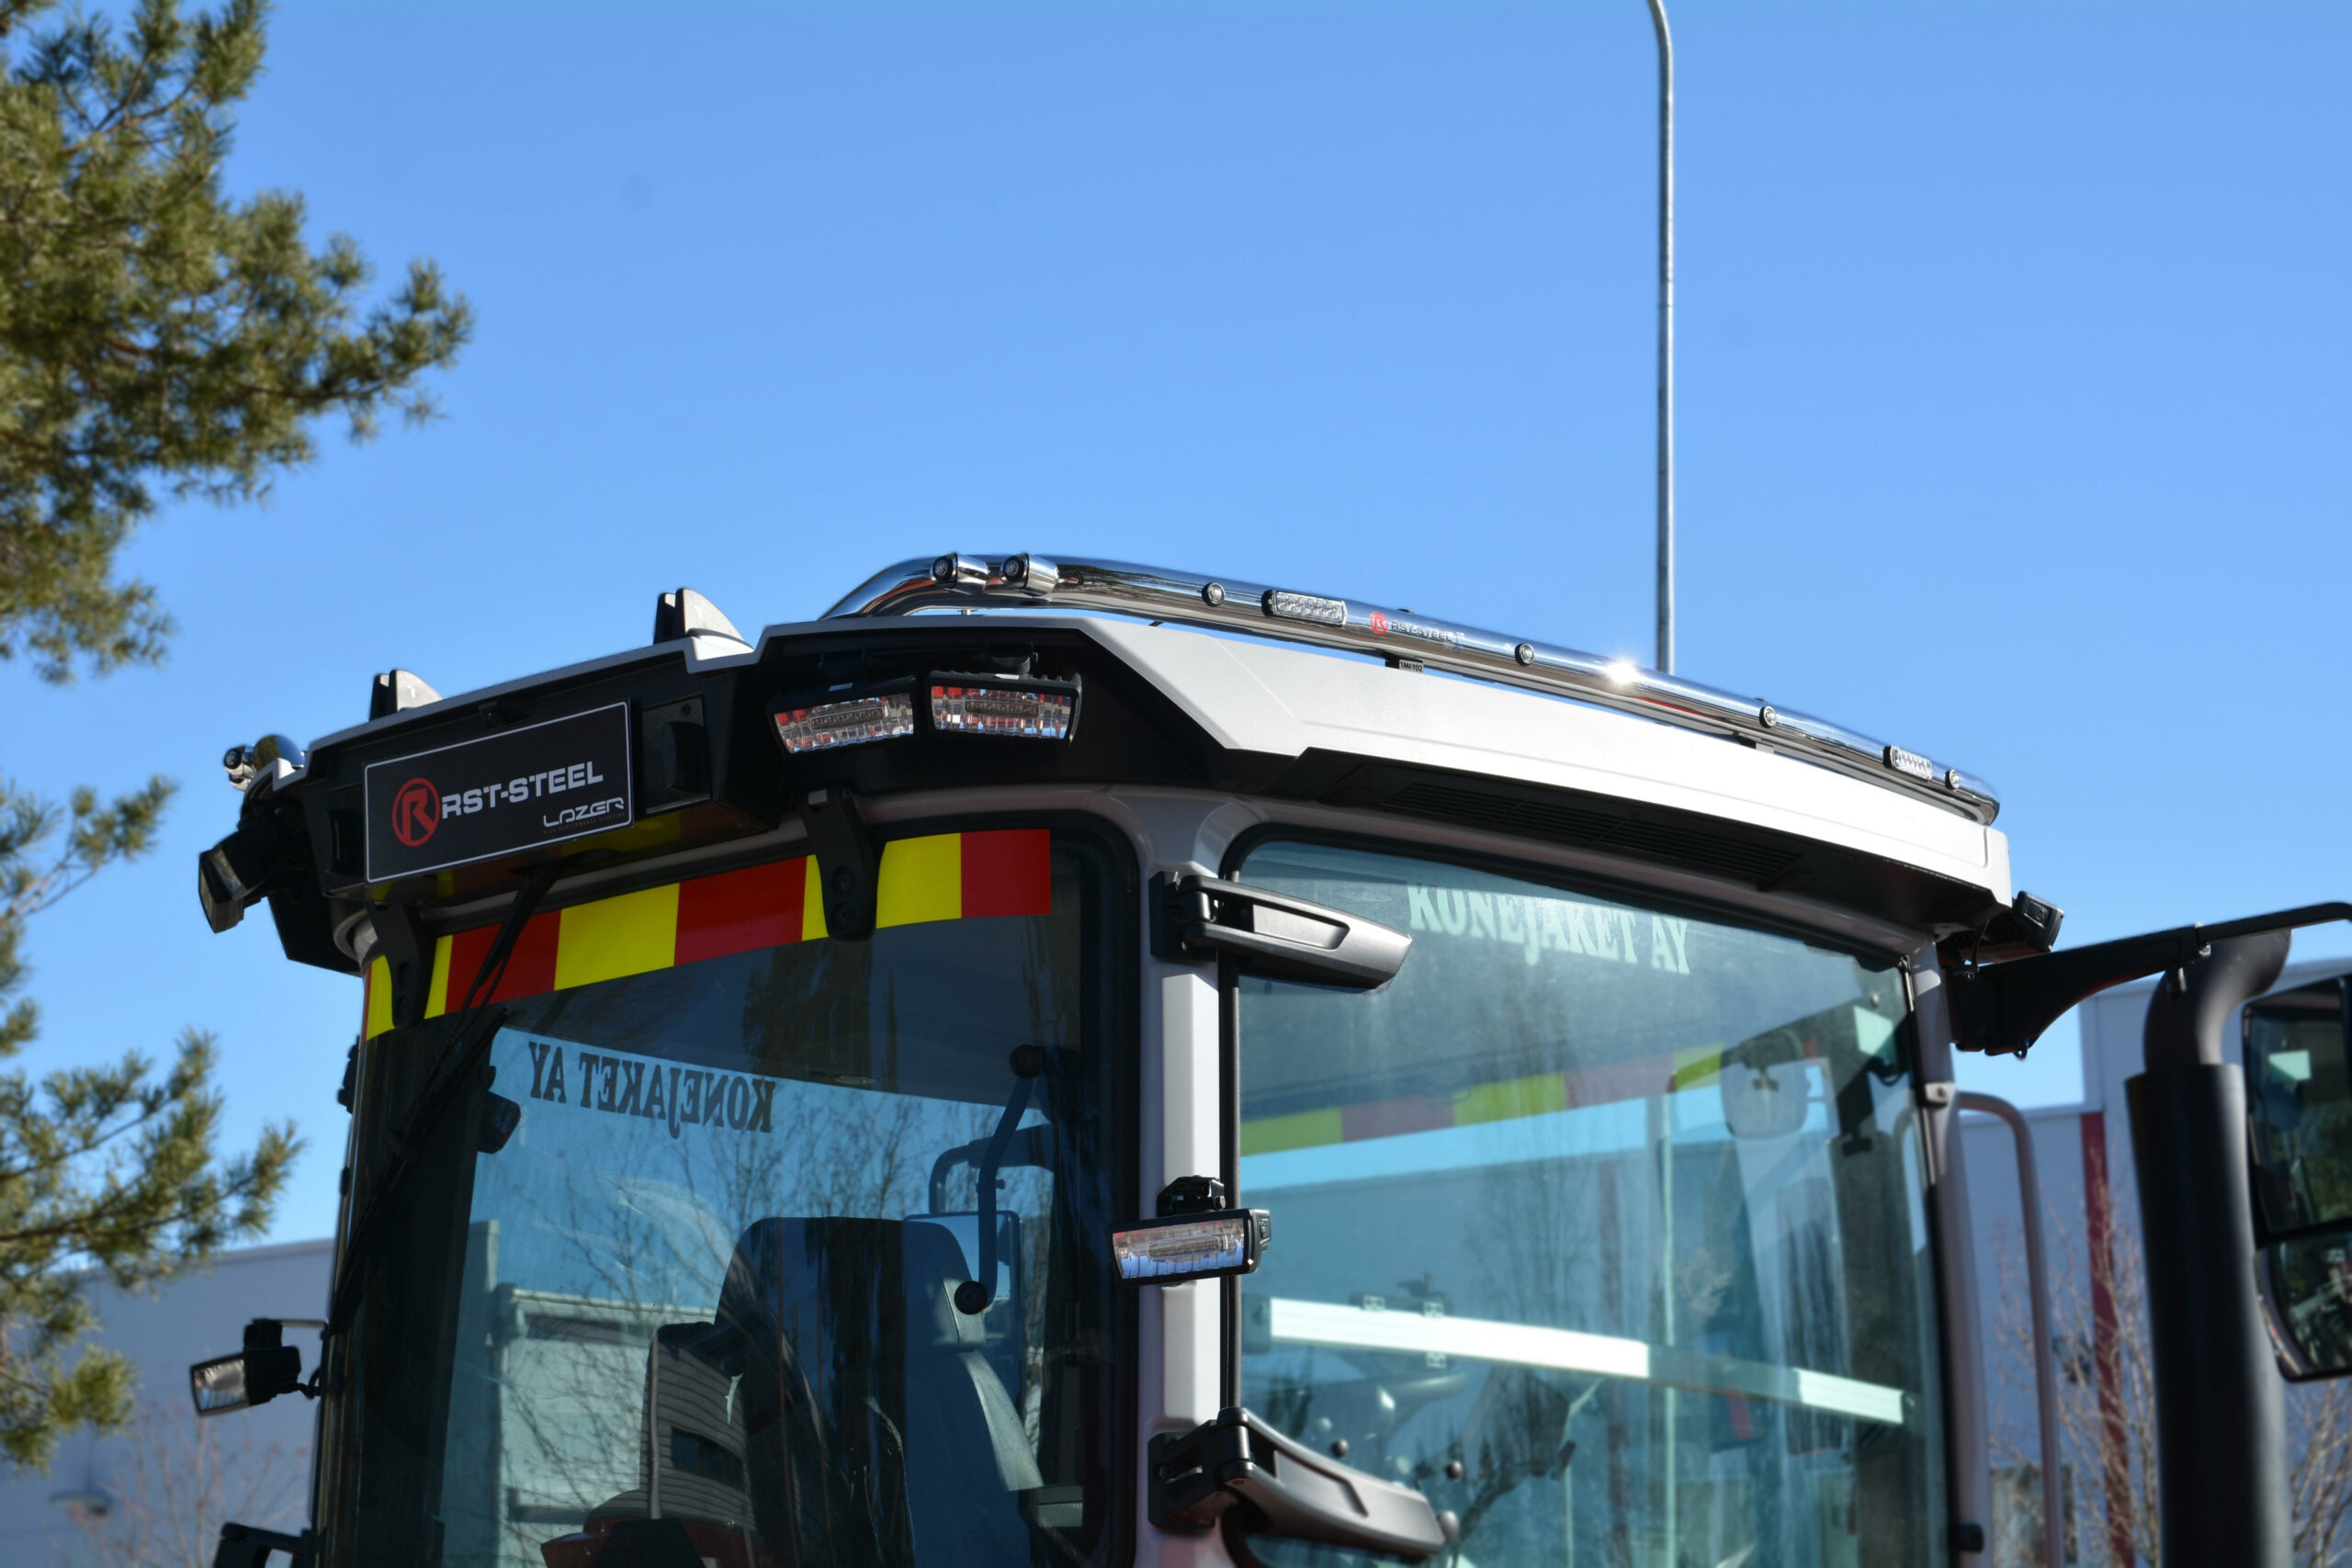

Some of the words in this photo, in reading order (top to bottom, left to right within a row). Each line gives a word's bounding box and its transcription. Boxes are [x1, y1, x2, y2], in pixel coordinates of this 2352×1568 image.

[1391, 621, 1453, 642] RST-STEEL
[442, 761, 604, 819] RST-STEEL
[544, 797, 624, 827] LAZER
[1407, 884, 1637, 966] KONEJAKET
[1652, 915, 1690, 976] AY
